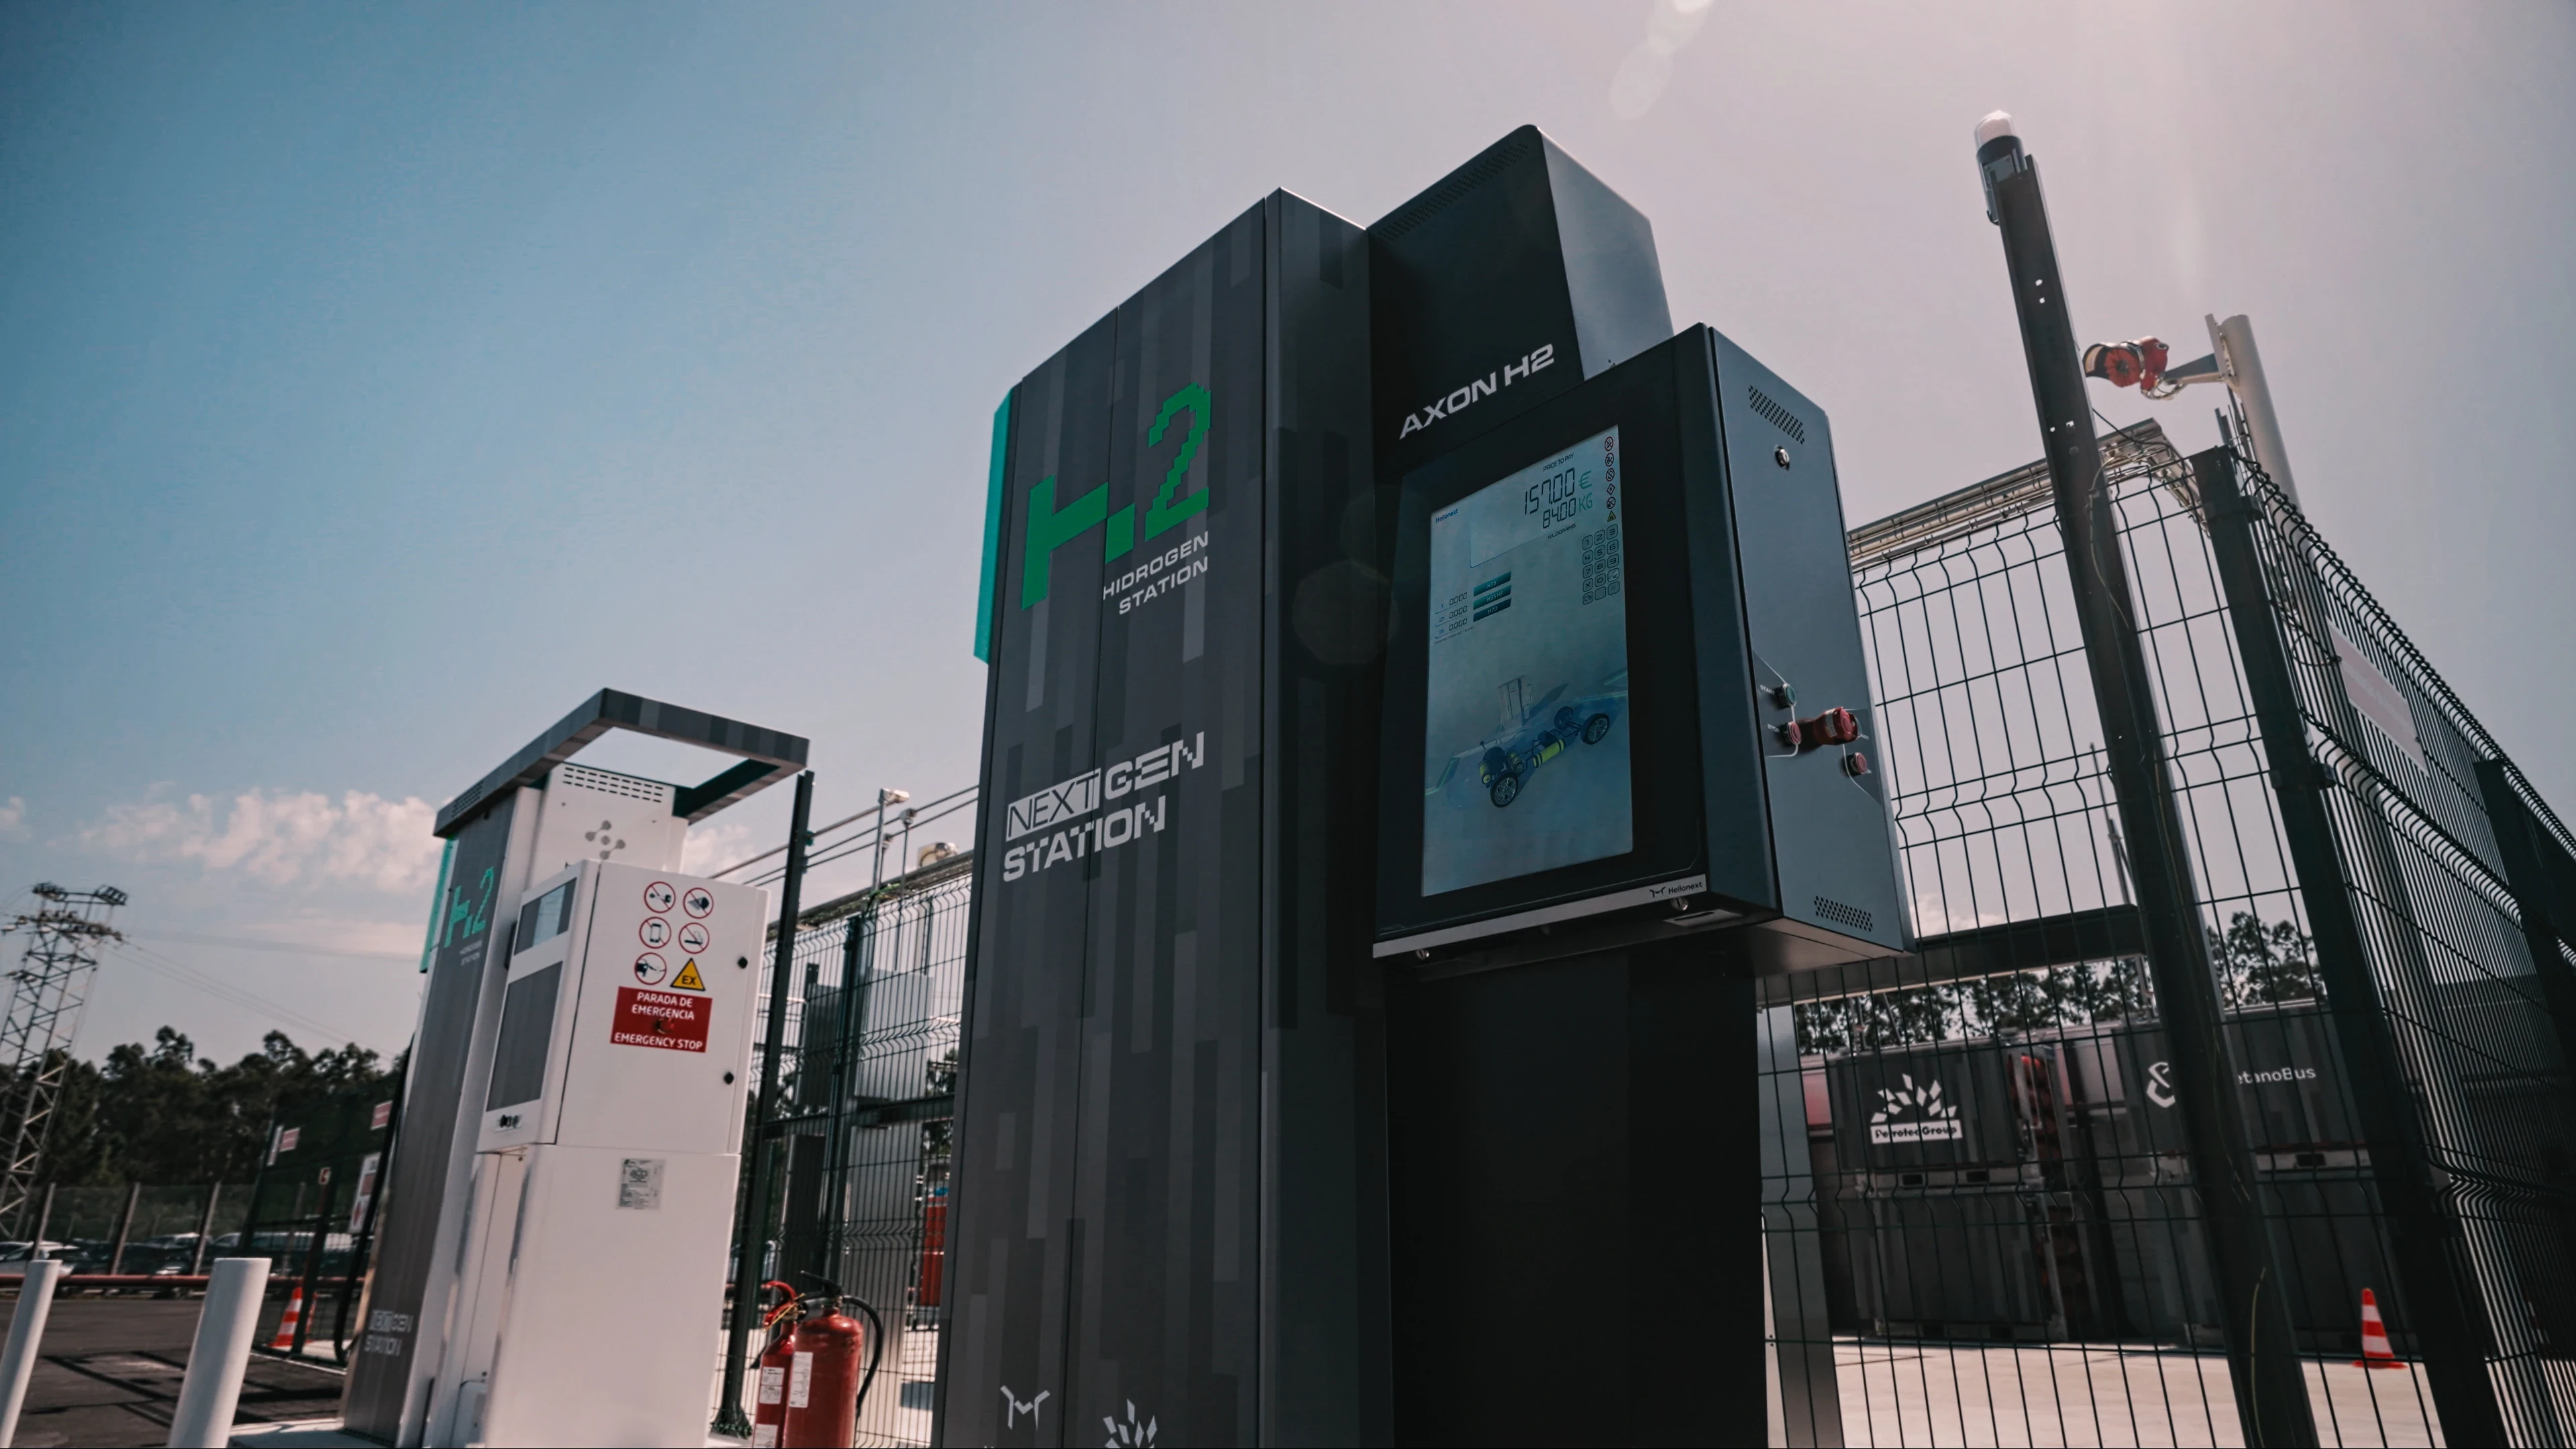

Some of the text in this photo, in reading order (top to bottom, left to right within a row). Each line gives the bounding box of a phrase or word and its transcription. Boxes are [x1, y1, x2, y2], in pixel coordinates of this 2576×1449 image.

[1399, 343, 1554, 440] AXON H2
[1544, 460, 1557, 472] PRICE
[1564, 453, 1574, 462] PAY
[1524, 468, 1593, 515] 157.00 €
[1436, 508, 1458, 523] Hellonext
[1542, 492, 1593, 529] 84.00 KG
[1548, 523, 1576, 539] KILOGRAMS
[1102, 531, 1209, 601] HIDROGEN
[1119, 555, 1208, 615] STATION
[1487, 580, 1497, 589] H35
[1487, 594, 1497, 602] H35
[1487, 606, 1497, 614] H70
[1003, 794, 1166, 882] STATION
[1668, 881, 1702, 894] Hellonext
[682, 975, 697, 985] EX
[637, 991, 694, 1008] PARADA DE
[631, 1004, 694, 1020] EMERGENCIA
[614, 1032, 704, 1050] EMERGENCY STOP
